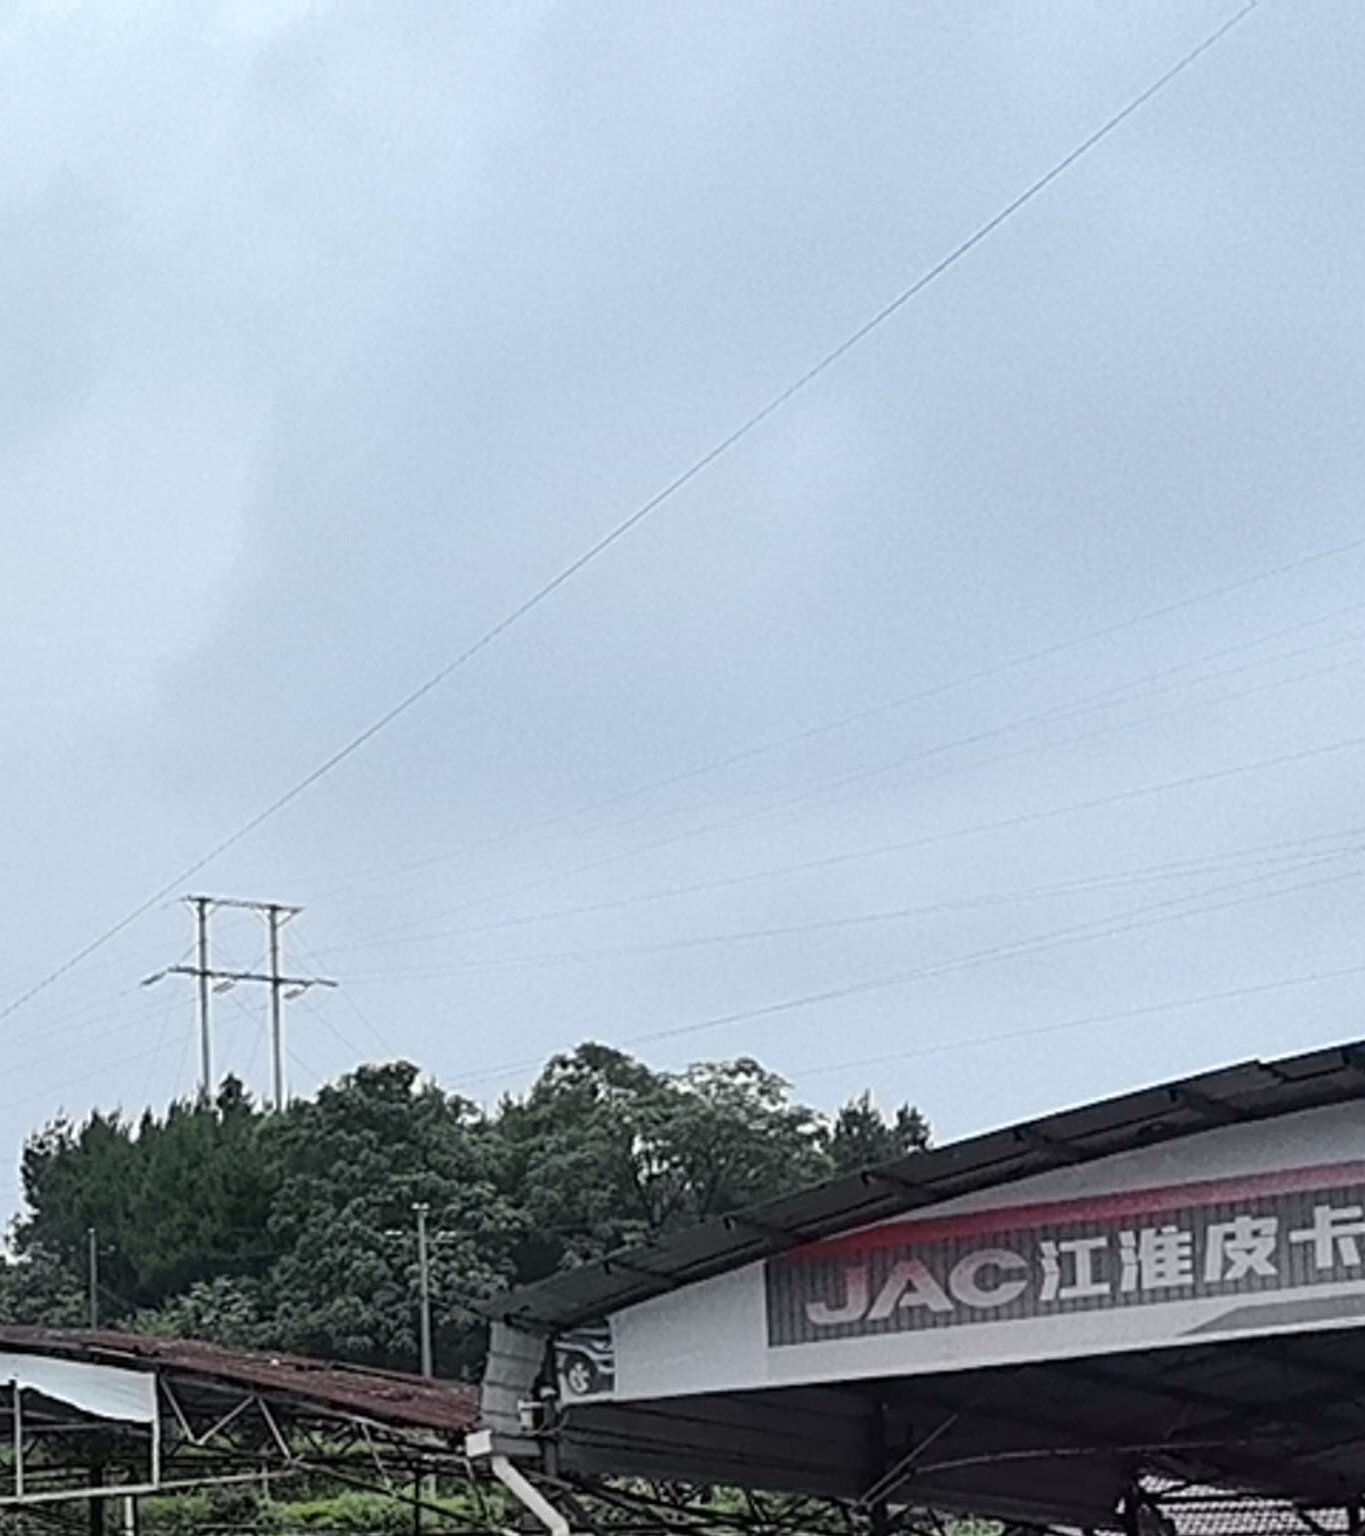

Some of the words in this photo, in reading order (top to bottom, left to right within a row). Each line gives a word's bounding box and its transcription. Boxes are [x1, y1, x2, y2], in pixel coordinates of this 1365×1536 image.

[806, 1248, 1029, 1326] JAC
[1038, 1205, 1365, 1301] 江淮皮卡
